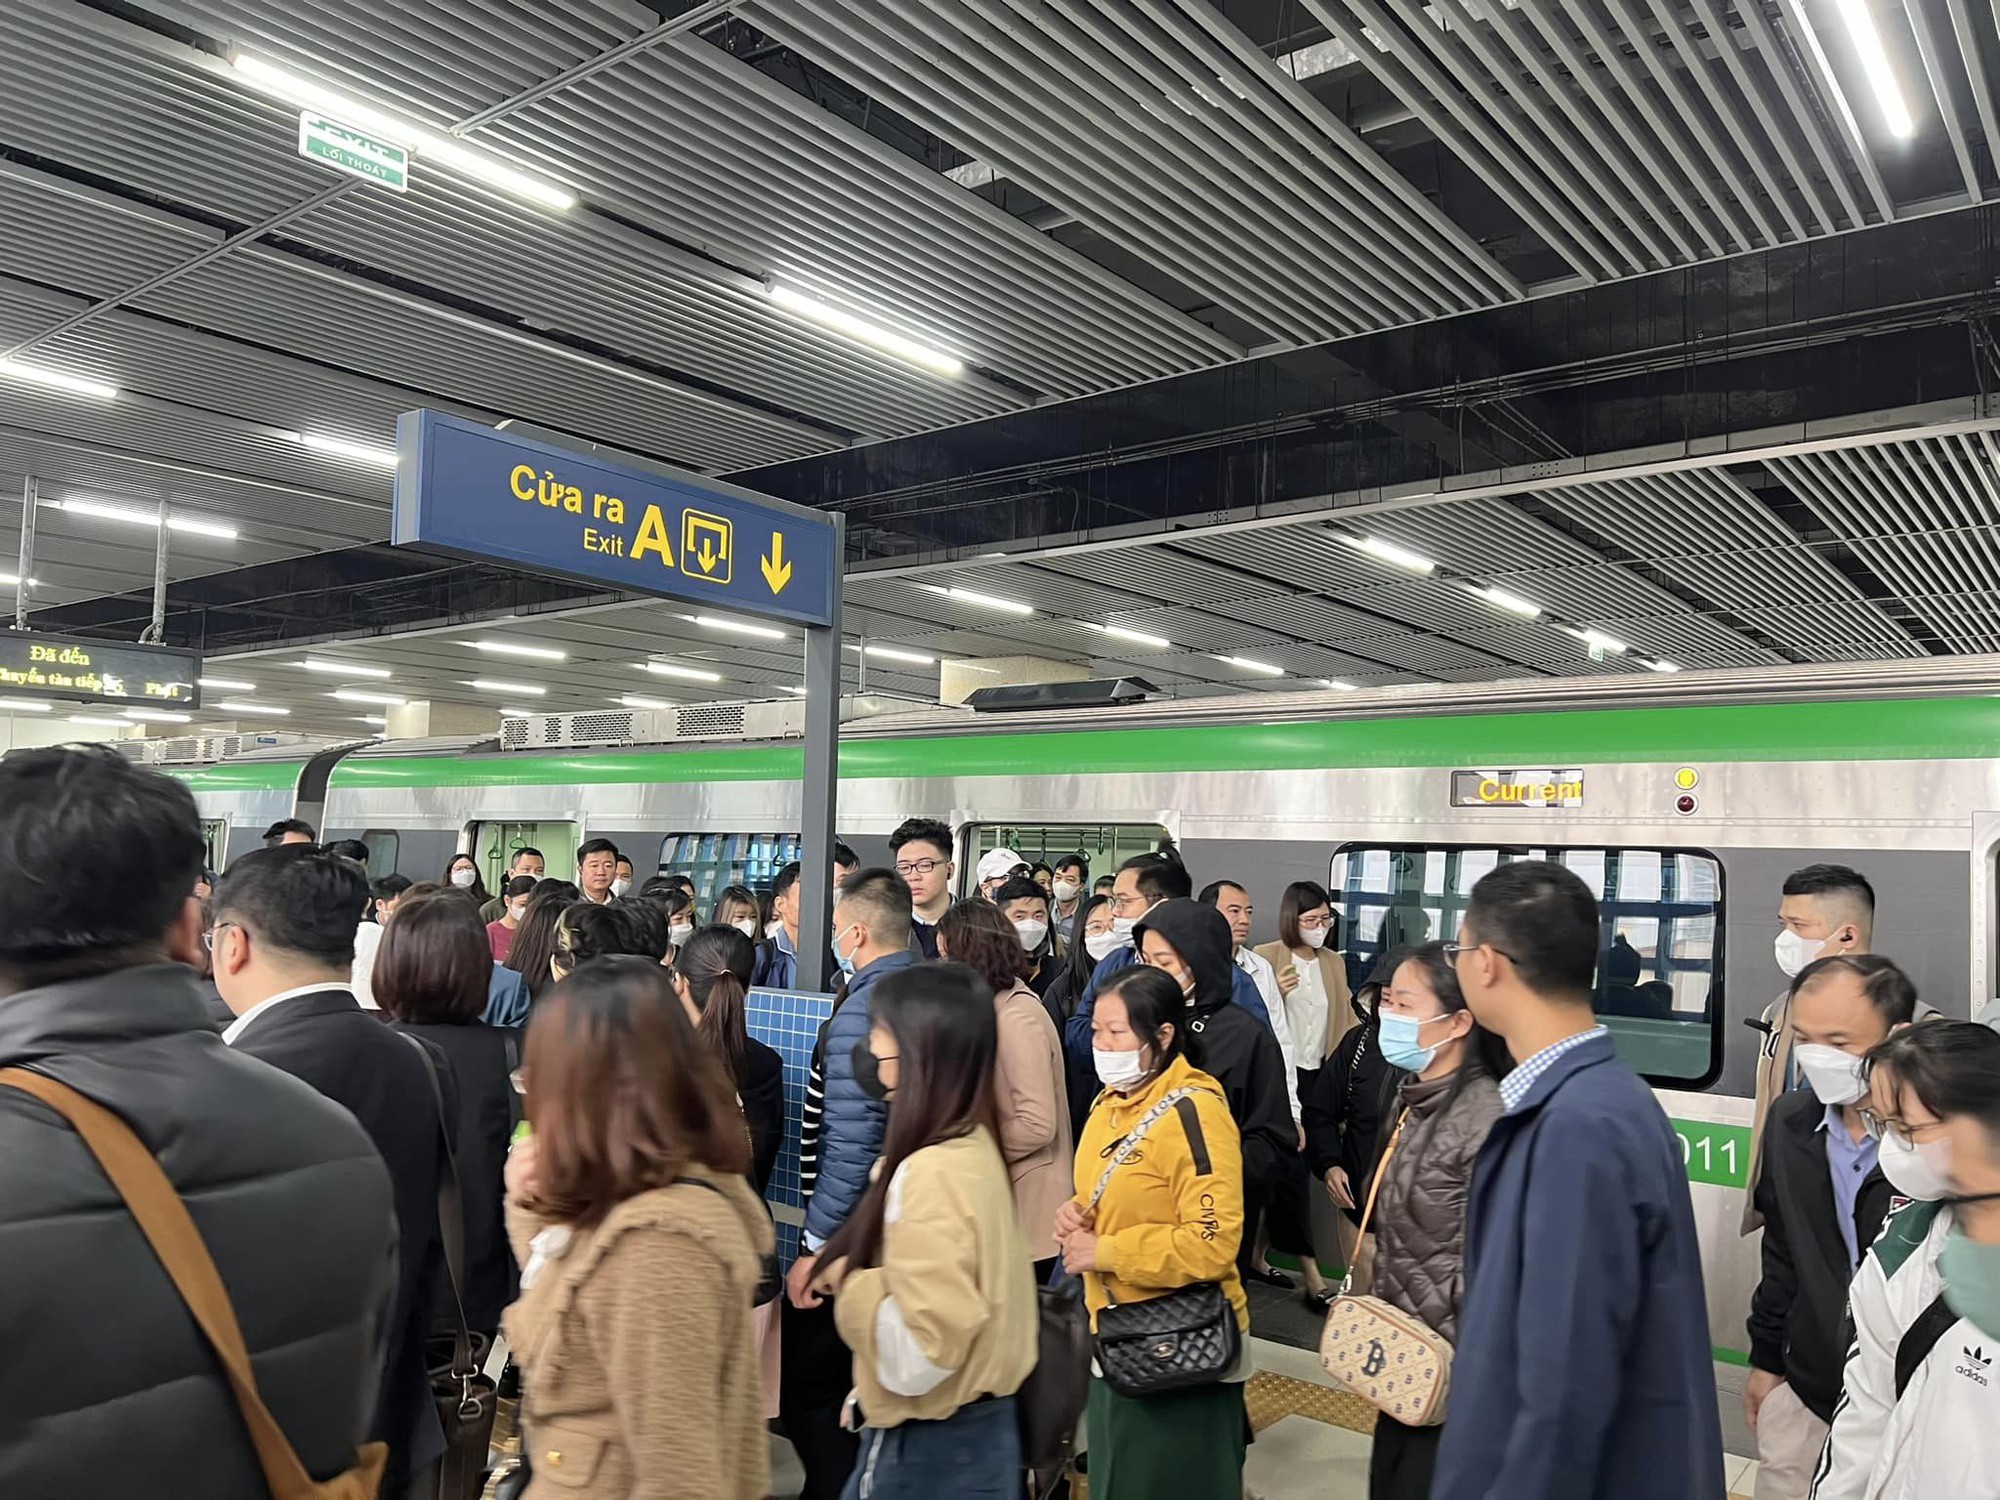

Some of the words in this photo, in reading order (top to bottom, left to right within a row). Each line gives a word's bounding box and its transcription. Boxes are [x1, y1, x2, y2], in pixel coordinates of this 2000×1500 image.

[510, 464, 583, 514] Cửa
[593, 493, 624, 524] ra
[583, 527, 624, 557] Exit
[629, 504, 675, 567] A
[30, 645, 57, 662] Đã
[1478, 778, 1583, 802] Current
[1955, 1365, 1988, 1387] adidas
